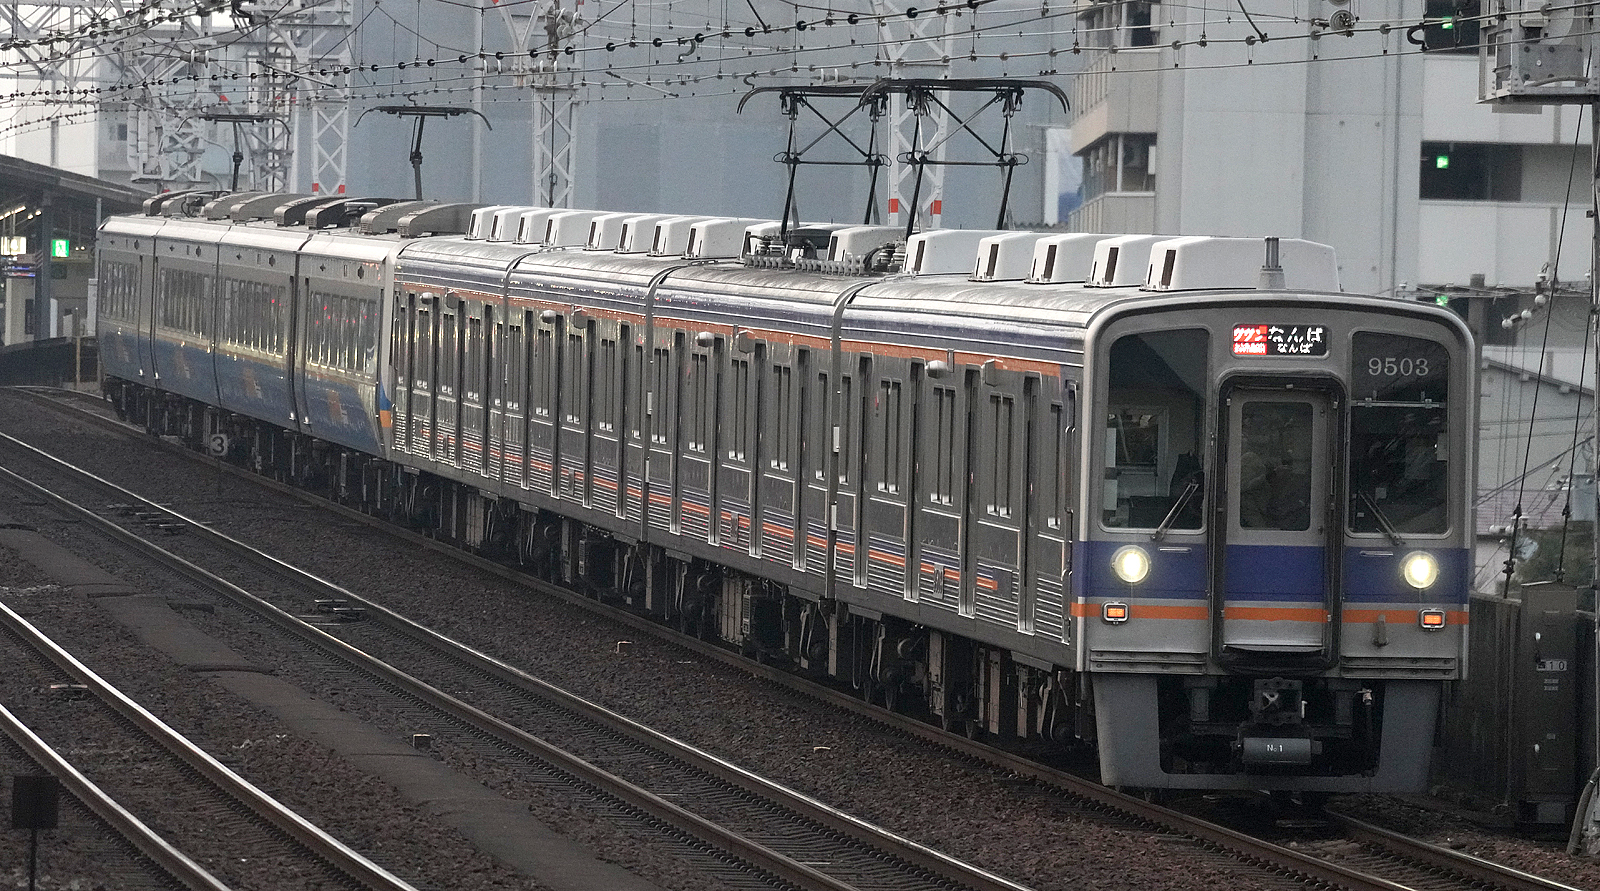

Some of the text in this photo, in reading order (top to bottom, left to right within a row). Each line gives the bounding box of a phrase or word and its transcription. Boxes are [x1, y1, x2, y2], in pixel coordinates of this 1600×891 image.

[1267, 325, 1323, 343] なんば
[1277, 342, 1314, 354] なんば
[1368, 357, 1429, 376] 9503
[212, 436, 225, 453] 3
